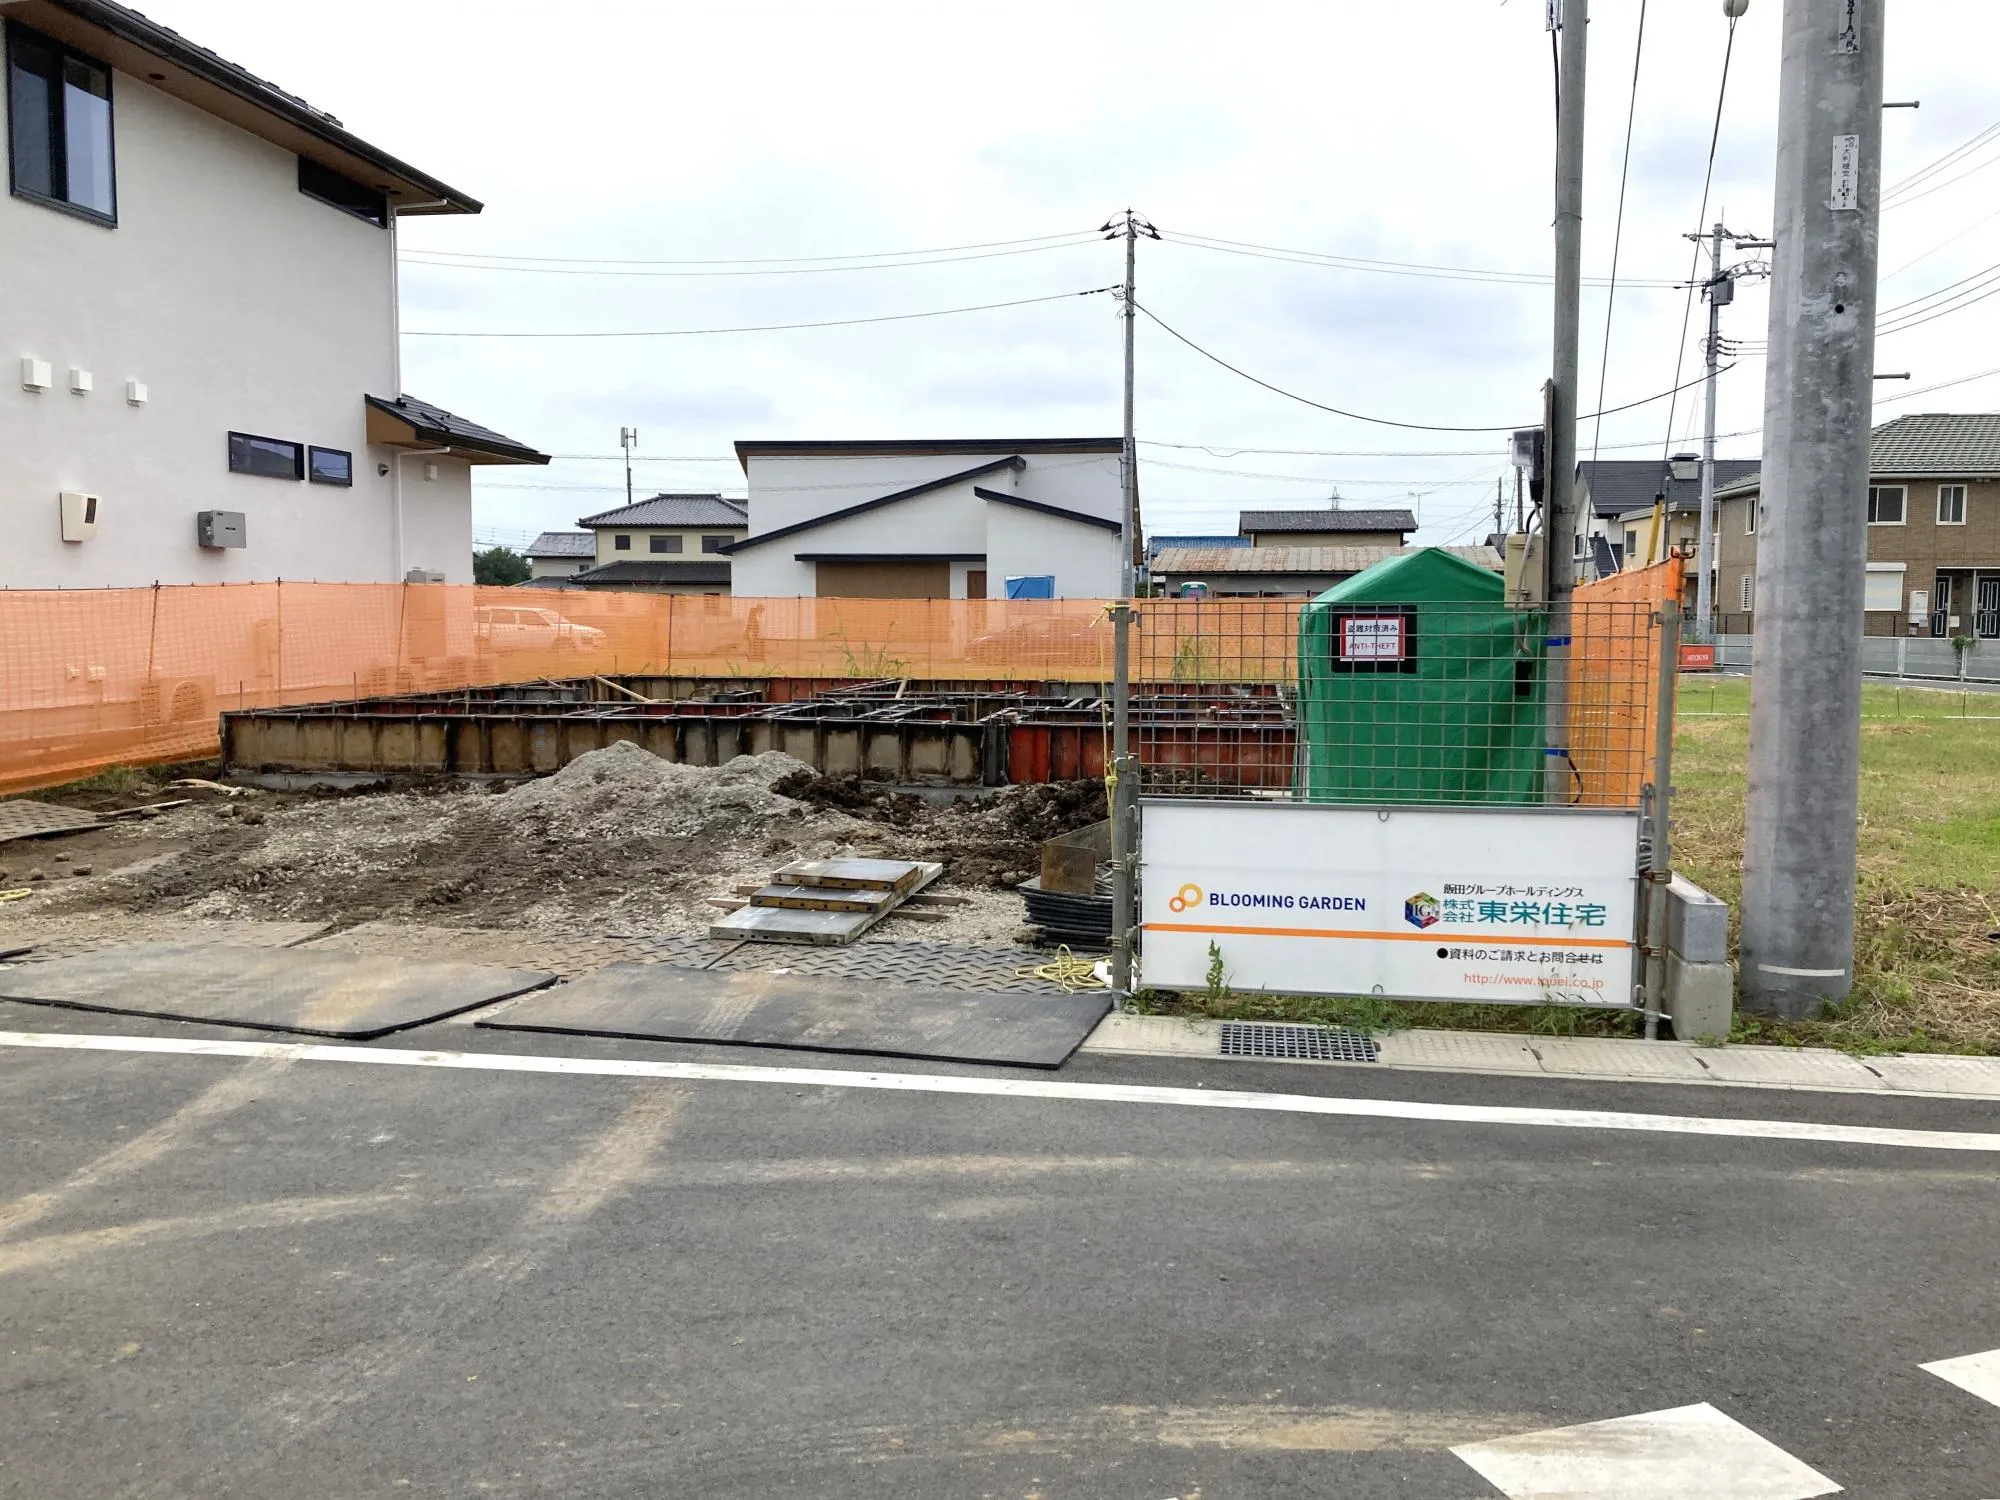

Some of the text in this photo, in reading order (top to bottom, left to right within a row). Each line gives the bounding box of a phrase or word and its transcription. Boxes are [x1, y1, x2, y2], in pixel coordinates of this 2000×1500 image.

[1349, 642, 1396, 650] ANTI-THEFT
[1443, 883, 1584, 898] 飯田グループホールディングス
[1209, 893, 1366, 911] BLOOMING GARDEN
[1442, 898, 1475, 911] 株式
[1442, 911, 1475, 924] 会社
[1477, 900, 1607, 927] 東栄住宅
